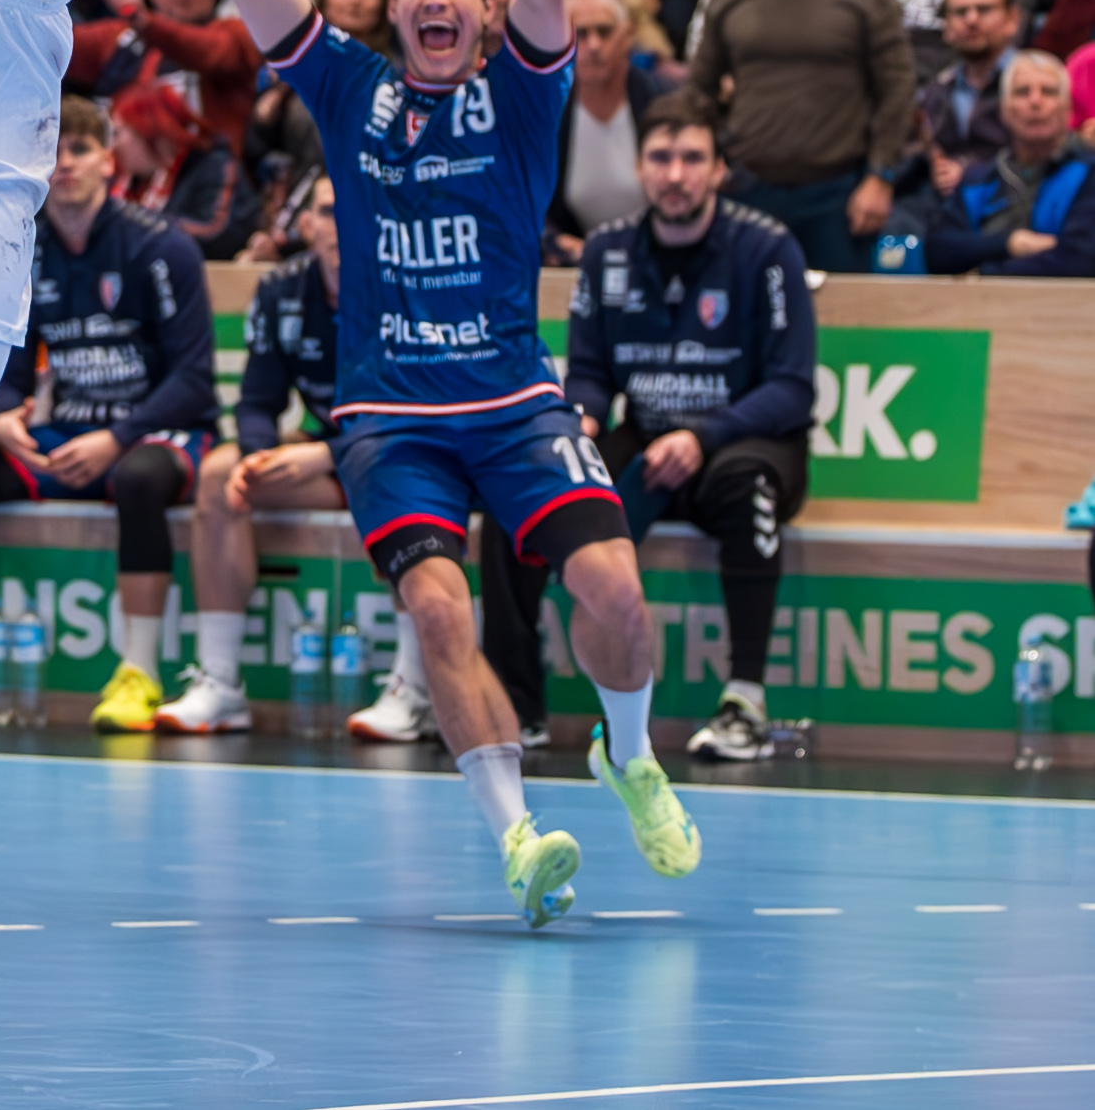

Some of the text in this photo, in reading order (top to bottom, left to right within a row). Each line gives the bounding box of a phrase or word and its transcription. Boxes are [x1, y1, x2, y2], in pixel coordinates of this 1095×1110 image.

[451, 77, 496, 137] 19
[379, 312, 492, 347] Plusnet
[552, 436, 614, 487] 19
[538, 598, 995, 694] ATREINES
[1018, 613, 1094, 699] S
